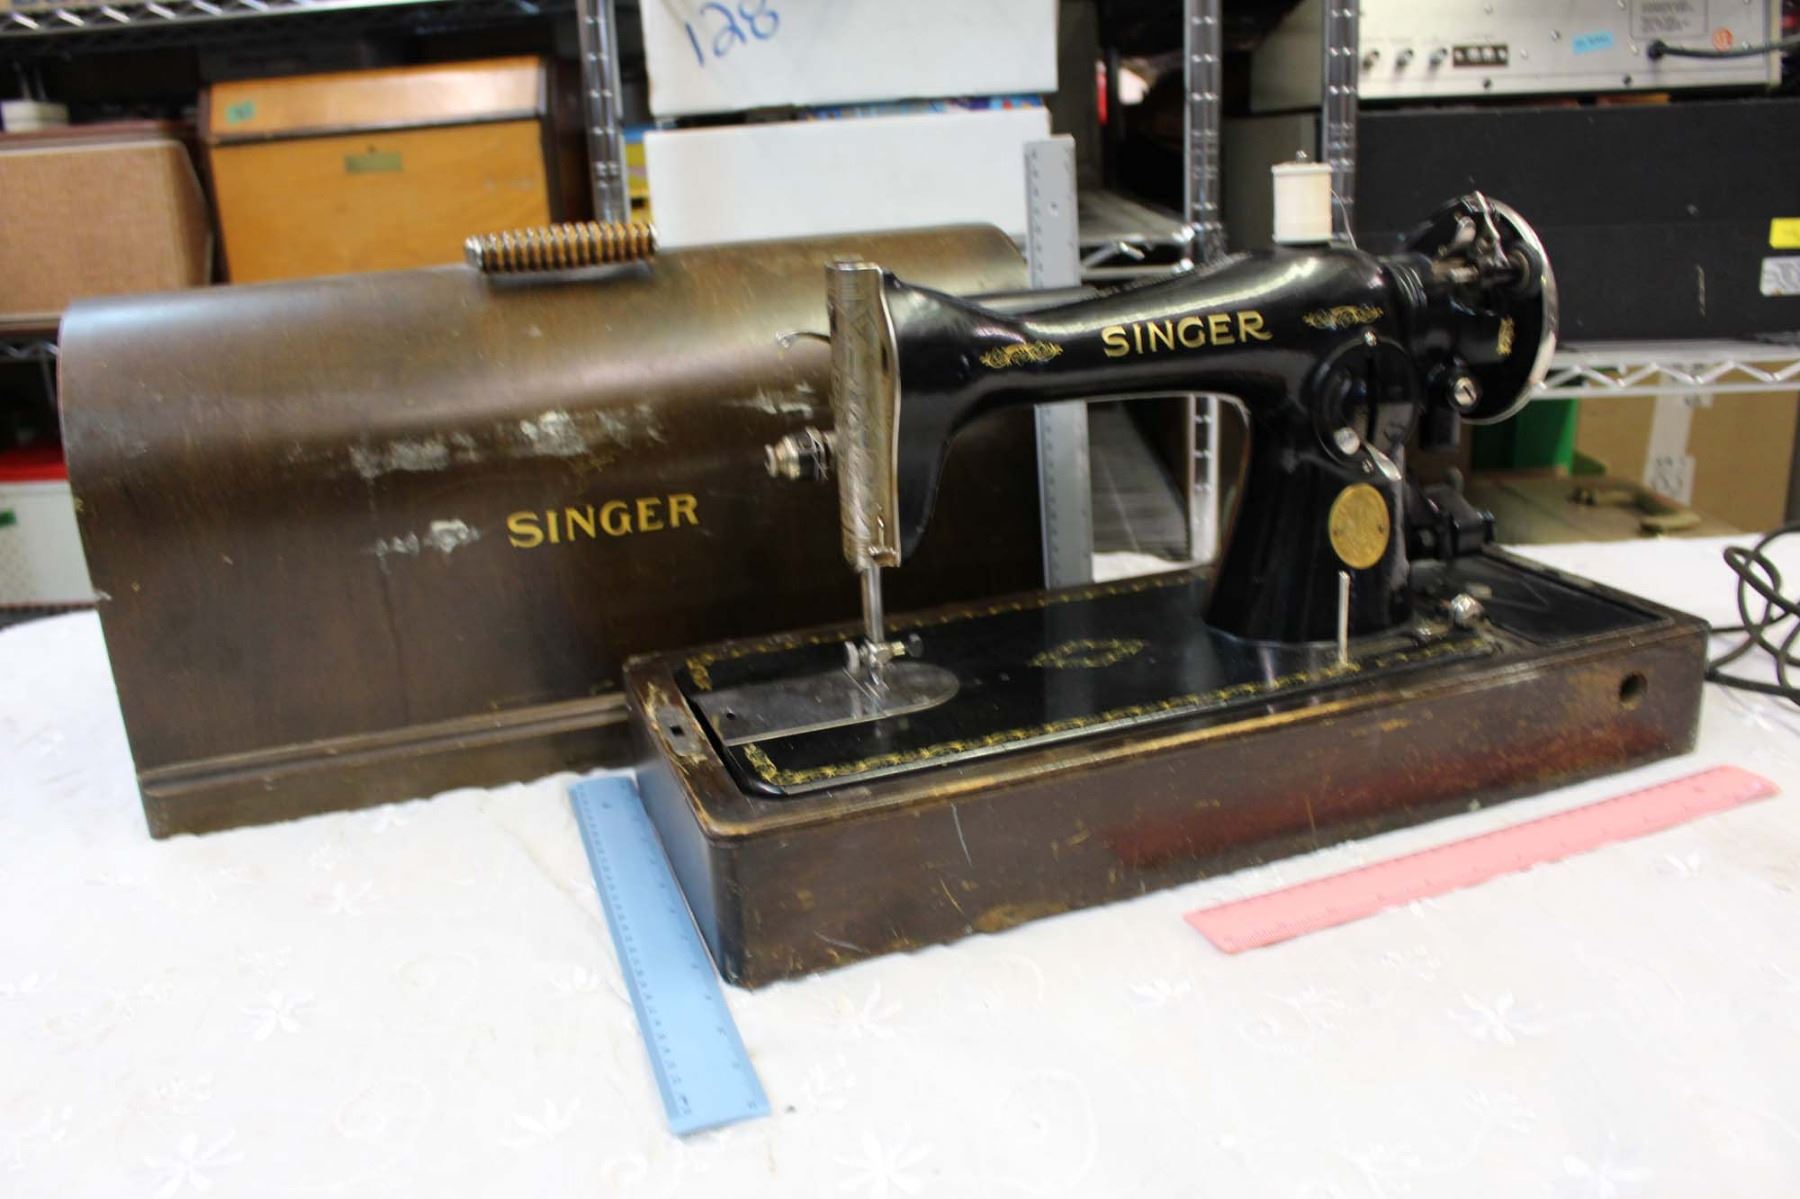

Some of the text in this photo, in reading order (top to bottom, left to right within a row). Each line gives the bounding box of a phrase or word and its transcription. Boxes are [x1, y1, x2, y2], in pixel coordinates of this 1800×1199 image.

[685, 0, 780, 66] 128
[1101, 310, 1273, 358] SINGER
[507, 493, 699, 549] SINGER
